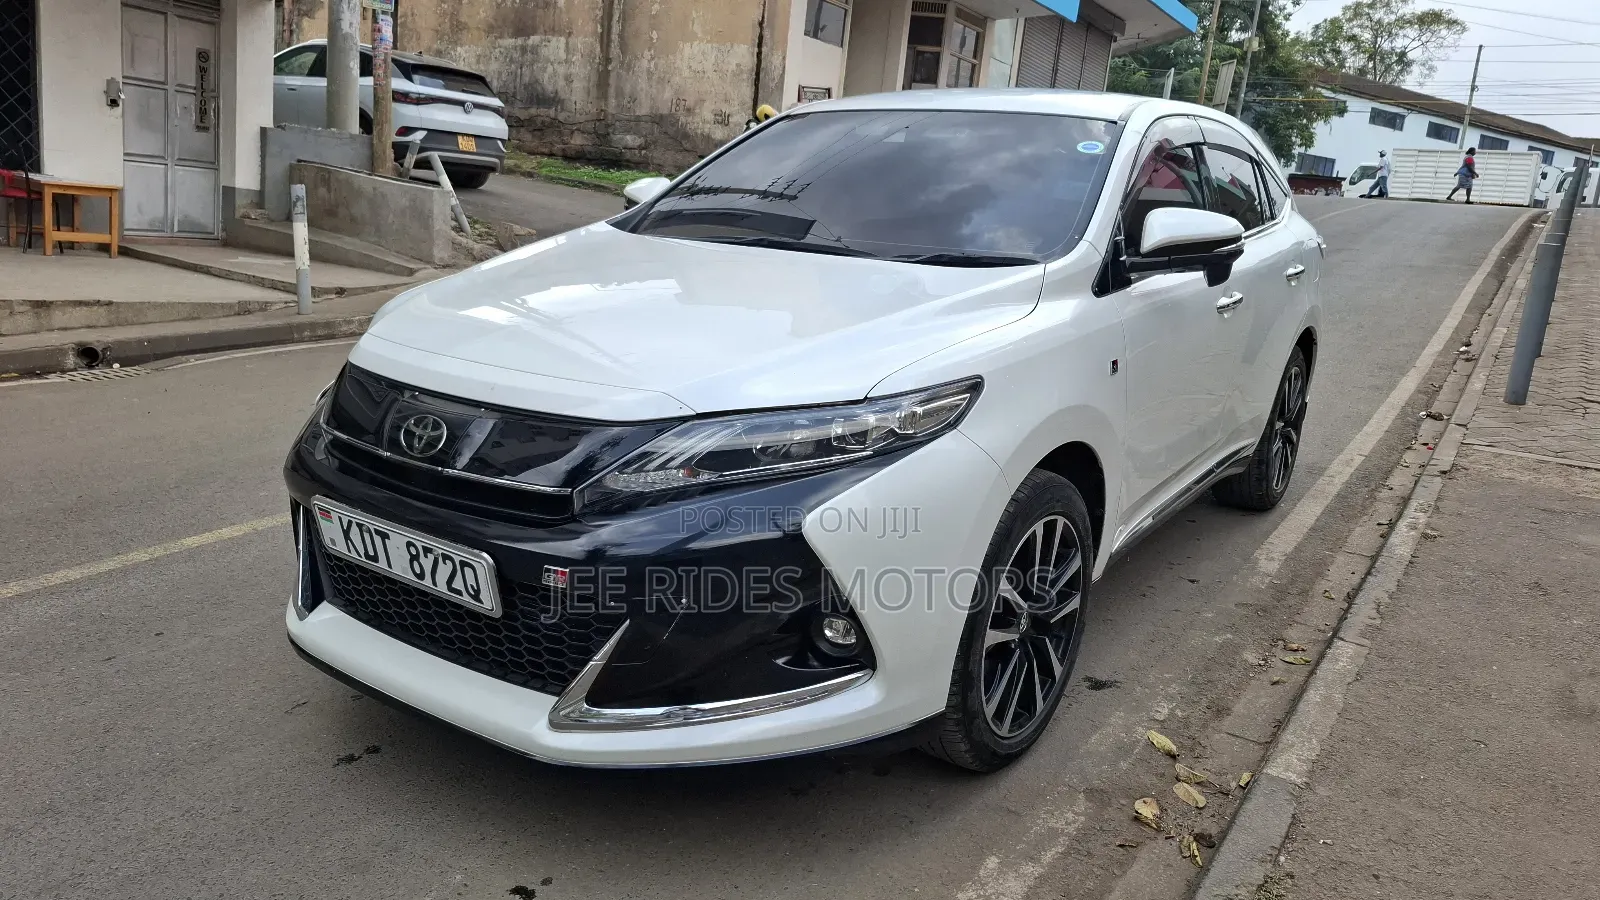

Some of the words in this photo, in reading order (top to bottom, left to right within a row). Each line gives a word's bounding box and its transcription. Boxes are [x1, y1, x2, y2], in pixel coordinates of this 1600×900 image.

[199, 65, 208, 124] WELCOME
[338, 516, 393, 570] KDT
[405, 540, 485, 605] 872Q
